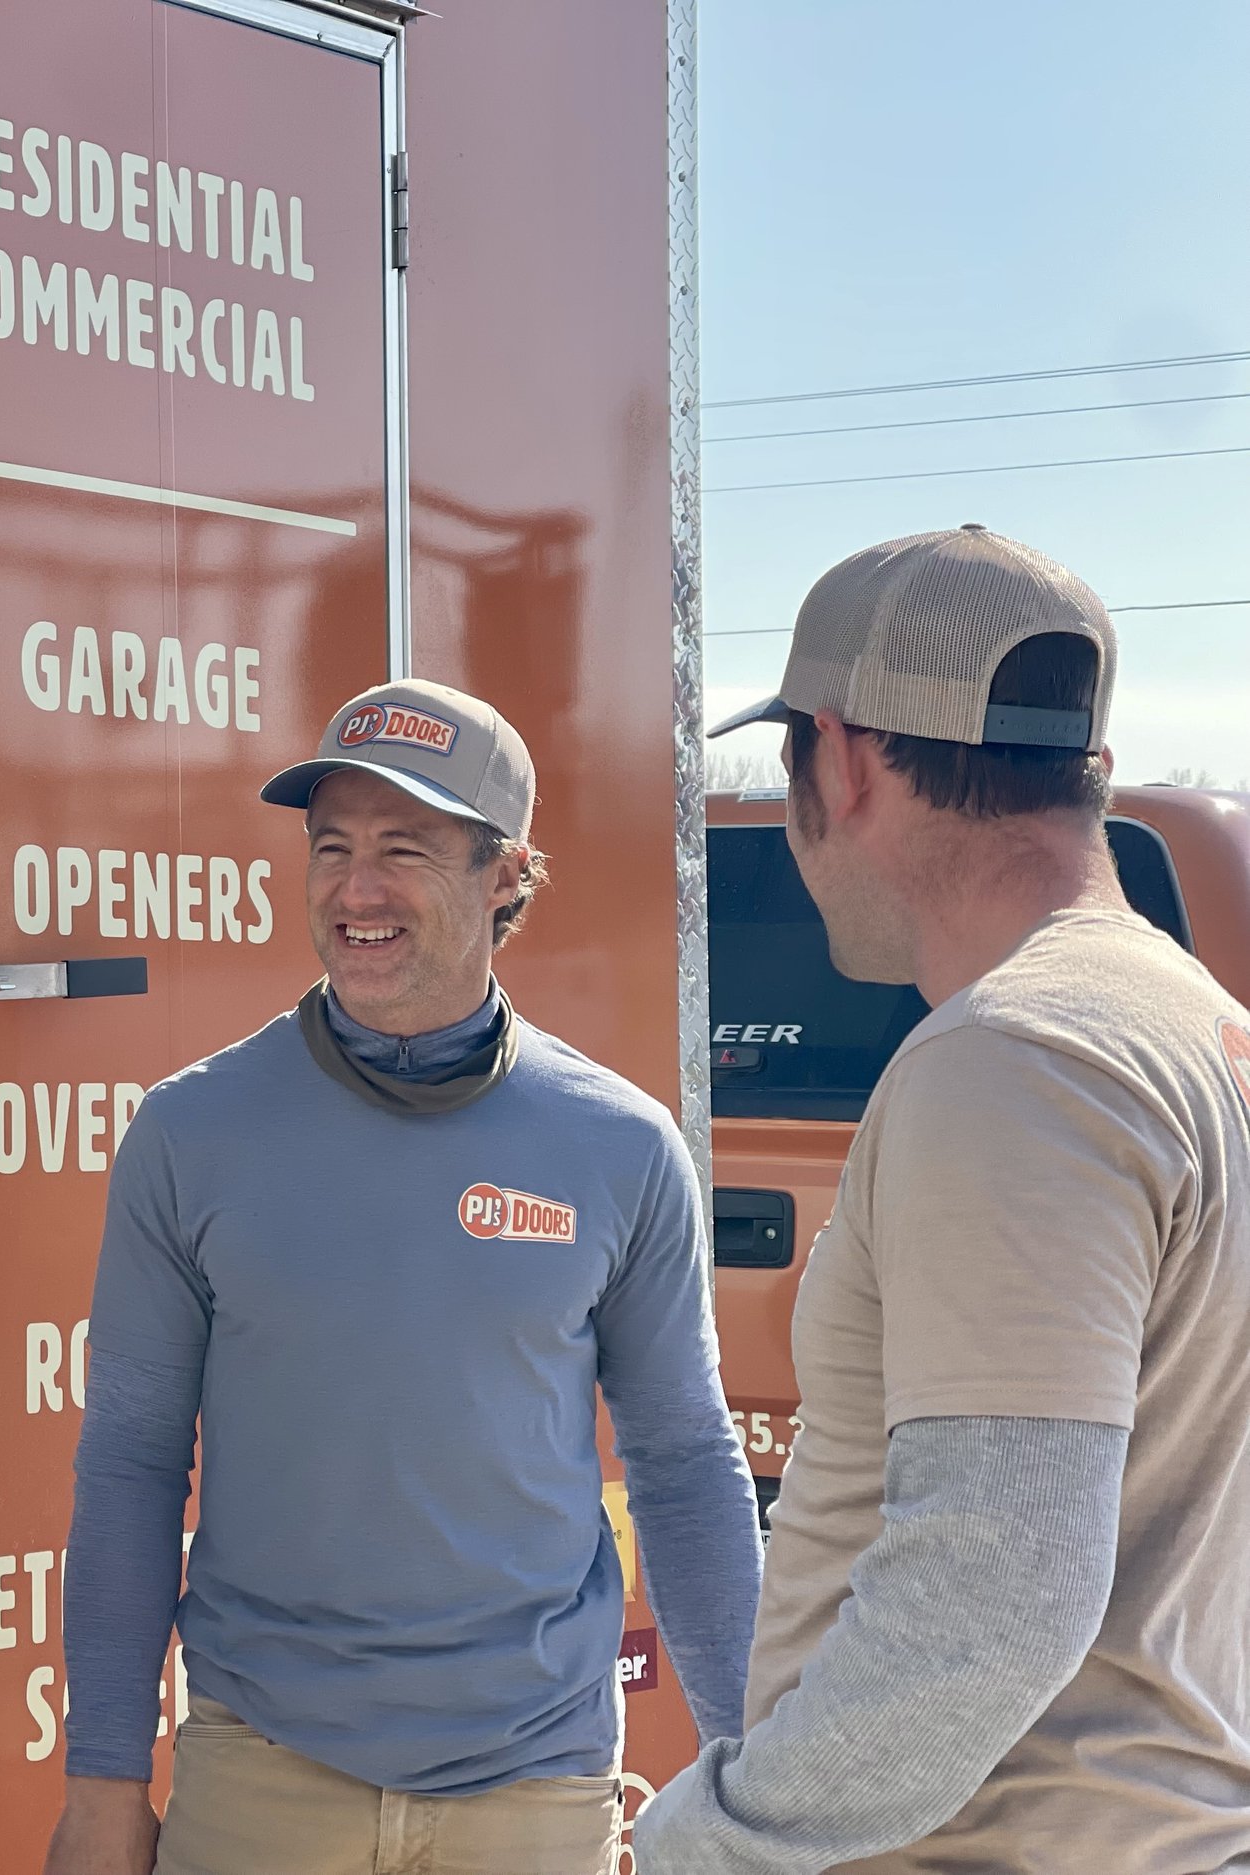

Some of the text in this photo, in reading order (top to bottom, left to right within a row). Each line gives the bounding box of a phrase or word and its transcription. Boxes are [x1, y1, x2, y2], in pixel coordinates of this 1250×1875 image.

[21, 620, 261, 733] GARAGE
[344, 711, 450, 747] PJ's DOORS
[13, 844, 274, 945] OPENERS
[712, 1024, 803, 1044] EER
[466, 1194, 571, 1236] PJ's DOORS
